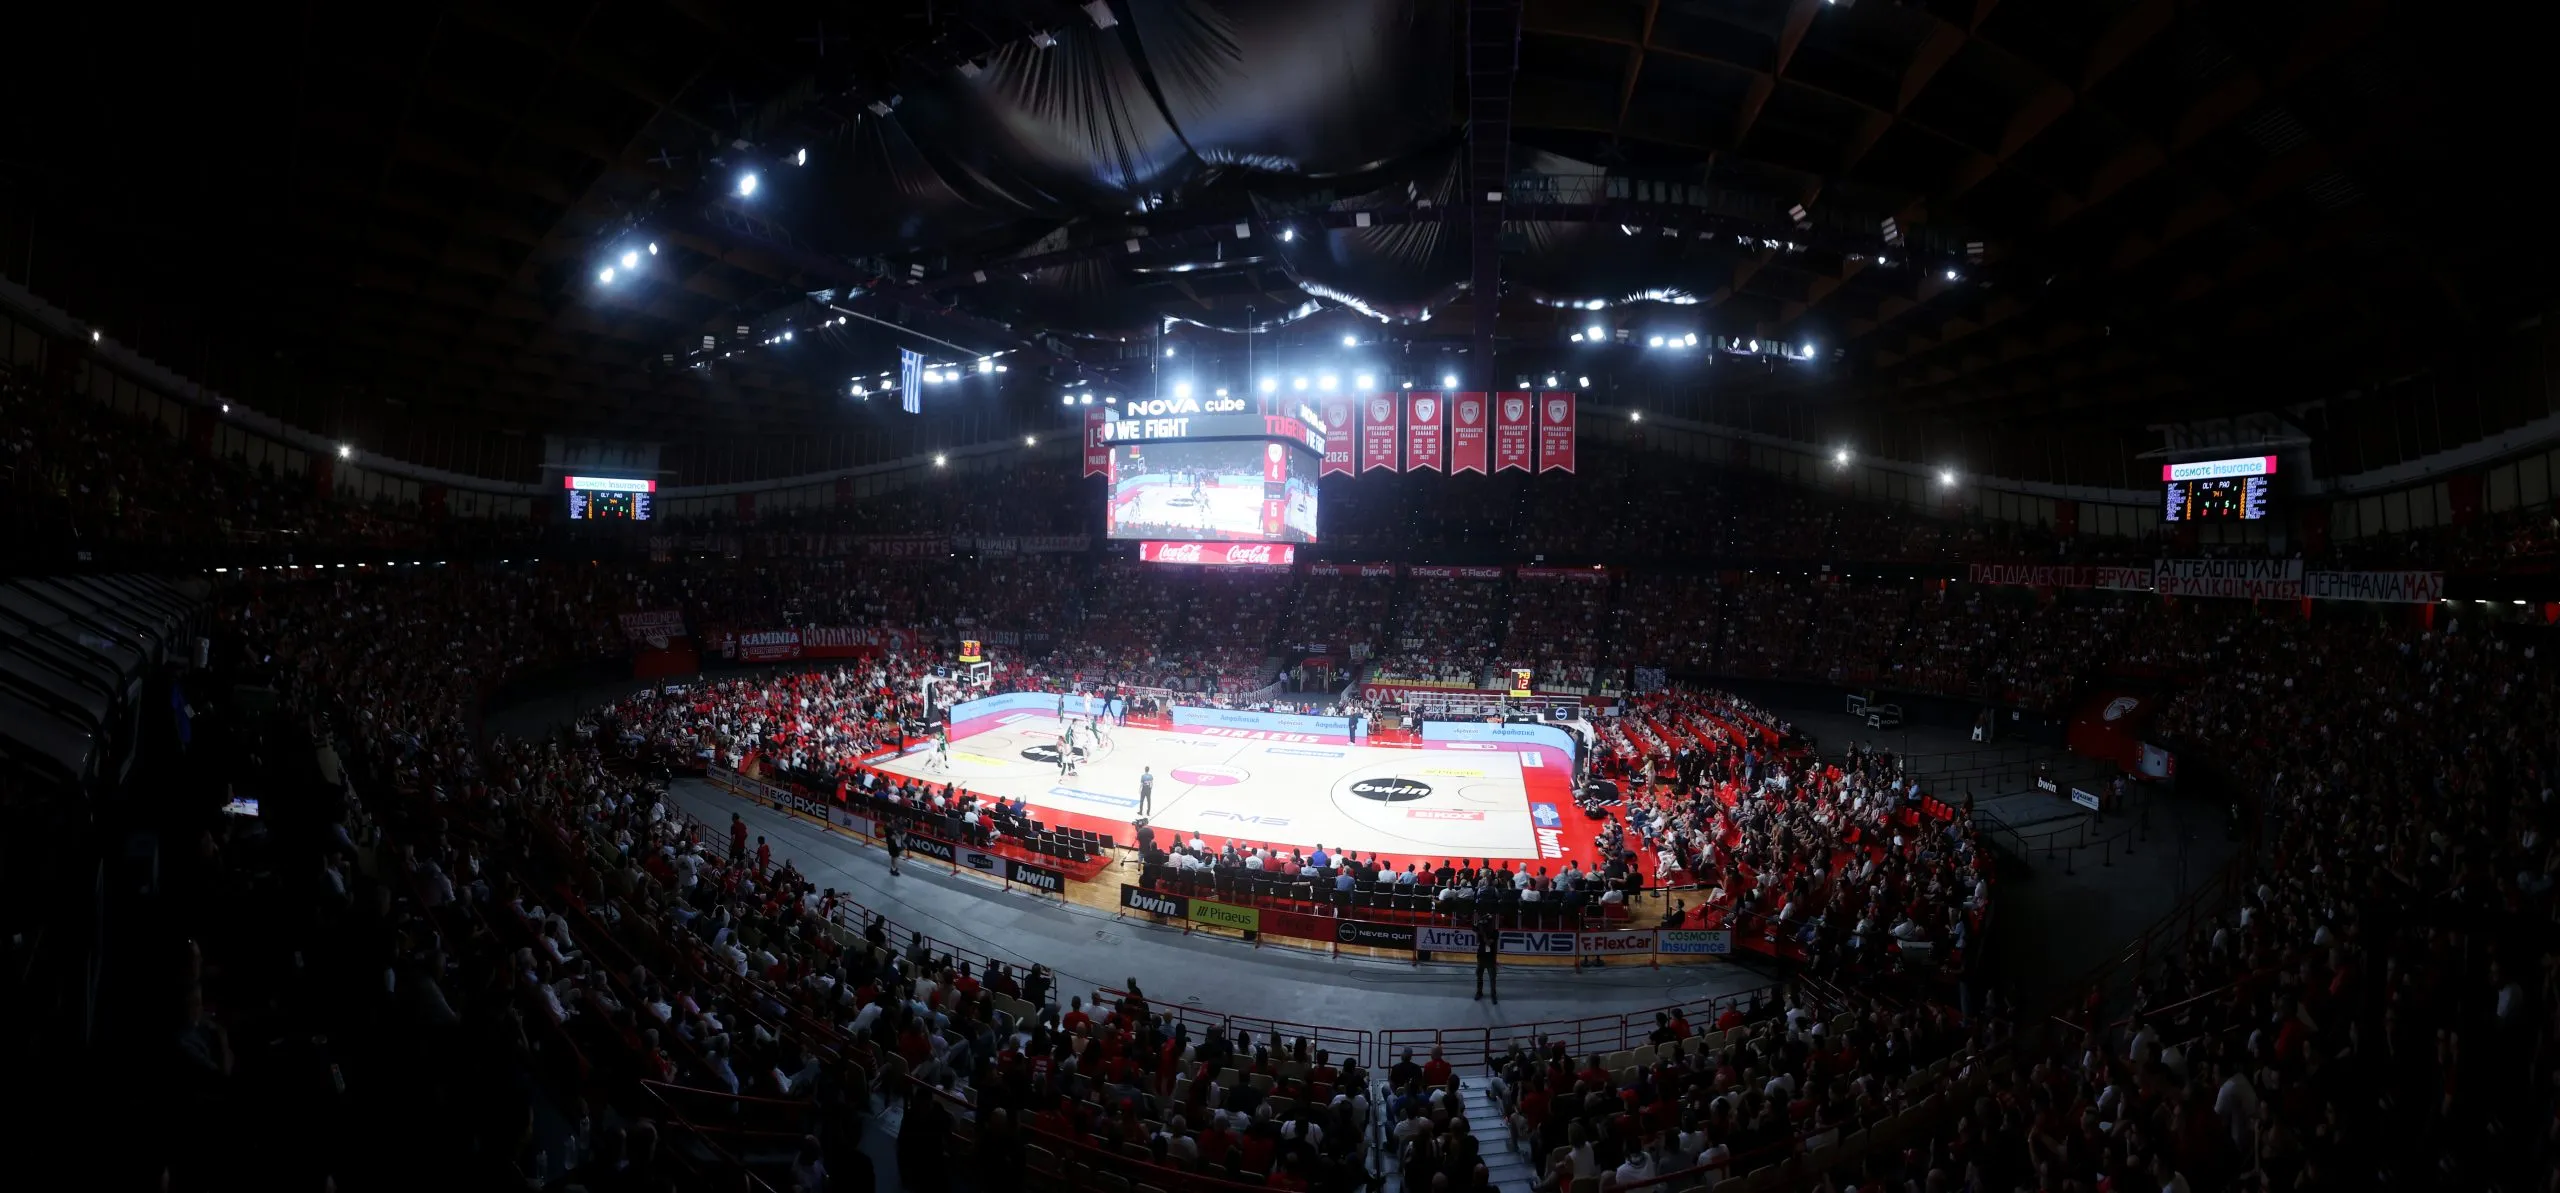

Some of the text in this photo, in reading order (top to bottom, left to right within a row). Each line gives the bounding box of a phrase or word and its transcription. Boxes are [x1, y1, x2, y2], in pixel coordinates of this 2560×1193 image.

[1128, 397, 1245, 416] NOVA cube
[1116, 418, 1189, 440] WE FIGHT
[1326, 451, 1349, 462] 2026
[1271, 464, 1279, 480] 4
[2174, 462, 2263, 477] COSMOTE Insurance
[608, 481, 646, 489] Insurance
[2202, 482, 2213, 490] OLY
[1311, 565, 1340, 576] bwin
[1361, 565, 1390, 577] bwin
[1419, 567, 1451, 577] FlexCar
[1468, 568, 1501, 578] FlexCar
[2158, 559, 2290, 578] ΑΓΓΕΛΟΠΟΥΛΟΙ
[2159, 577, 2302, 599] ΘΡΥΛΙΚΟΙ ΜΑΓΚΕΣ
[2307, 572, 2444, 601] ΠΕΡΗΦΑΝΙΑ ΜΑΣ
[741, 632, 800, 645] KAMINIA
[1518, 679, 1528, 690] 12
[1202, 728, 1321, 743] PIRAEUS
[1492, 729, 1535, 737] Ασφαλιστική
[1354, 782, 1431, 797] bwin
[2037, 776, 2057, 793] bwin
[770, 789, 792, 804] EKO
[794, 796, 827, 819] AXE
[1199, 809, 1292, 826] FMS
[909, 836, 952, 859] NOVA
[1536, 827, 1570, 860] bwin
[1016, 865, 1056, 890] bwin
[1129, 889, 1177, 916] bwin
[1210, 907, 1251, 925] Piraeus
[1359, 930, 1390, 939] NEVER
[1391, 932, 1414, 941] QUIT
[1500, 933, 1574, 952] FMS
[1594, 935, 1651, 951] FlexCar
[1668, 931, 1720, 942] COSMOTE
[1662, 939, 1725, 952] Insurance
